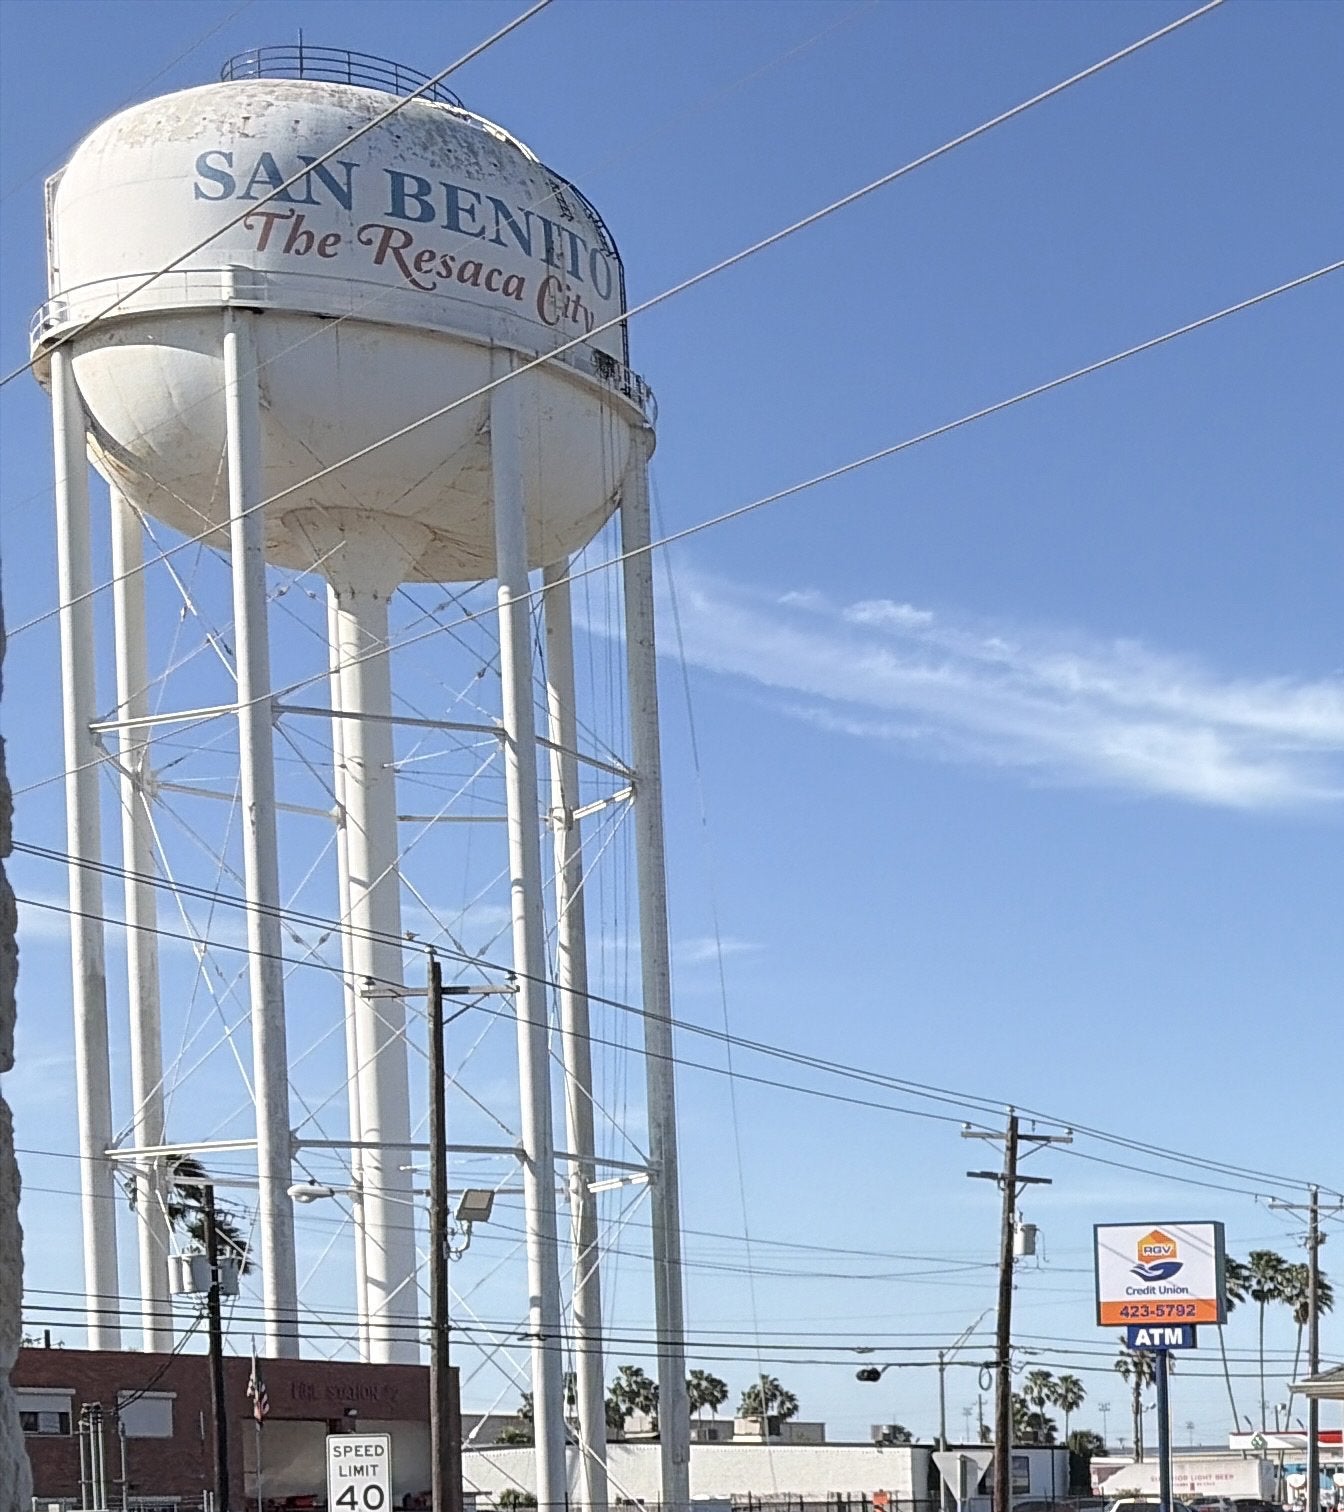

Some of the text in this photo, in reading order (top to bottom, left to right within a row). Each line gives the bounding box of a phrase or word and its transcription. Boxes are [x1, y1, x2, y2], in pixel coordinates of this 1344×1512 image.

[194, 150, 612, 300] SAN BENITO
[244, 208, 595, 334] The Resaca City
[1143, 1246, 1171, 1255] RGV
[1126, 1285, 1189, 1295] Credit Union
[1120, 1304, 1196, 1317] 423-5792
[1135, 1327, 1183, 1345] ATM
[333, 1444, 385, 1457] SPEED
[339, 1464, 379, 1477] LIMIT
[1190, 1473, 1212, 1482] LIGHT
[336, 1484, 385, 1511] 40
